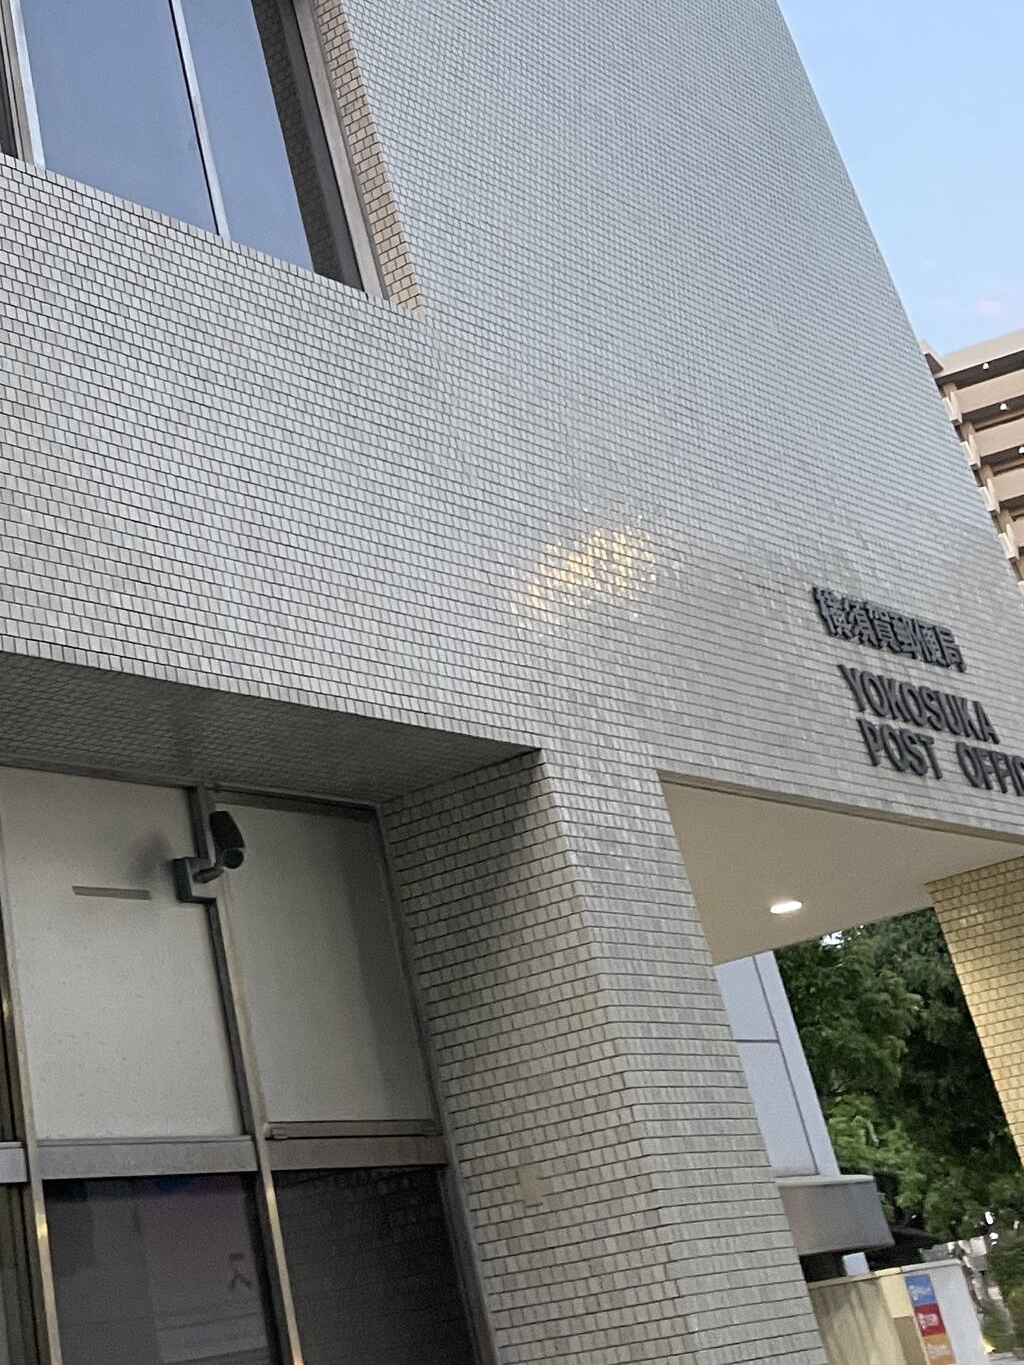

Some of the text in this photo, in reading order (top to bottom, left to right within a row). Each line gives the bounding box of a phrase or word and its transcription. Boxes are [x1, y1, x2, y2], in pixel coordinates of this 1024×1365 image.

[812, 586, 967, 673] 横須賀郵便局
[837, 664, 1000, 745] YOKOSUKA
[856, 717, 944, 780] POST
